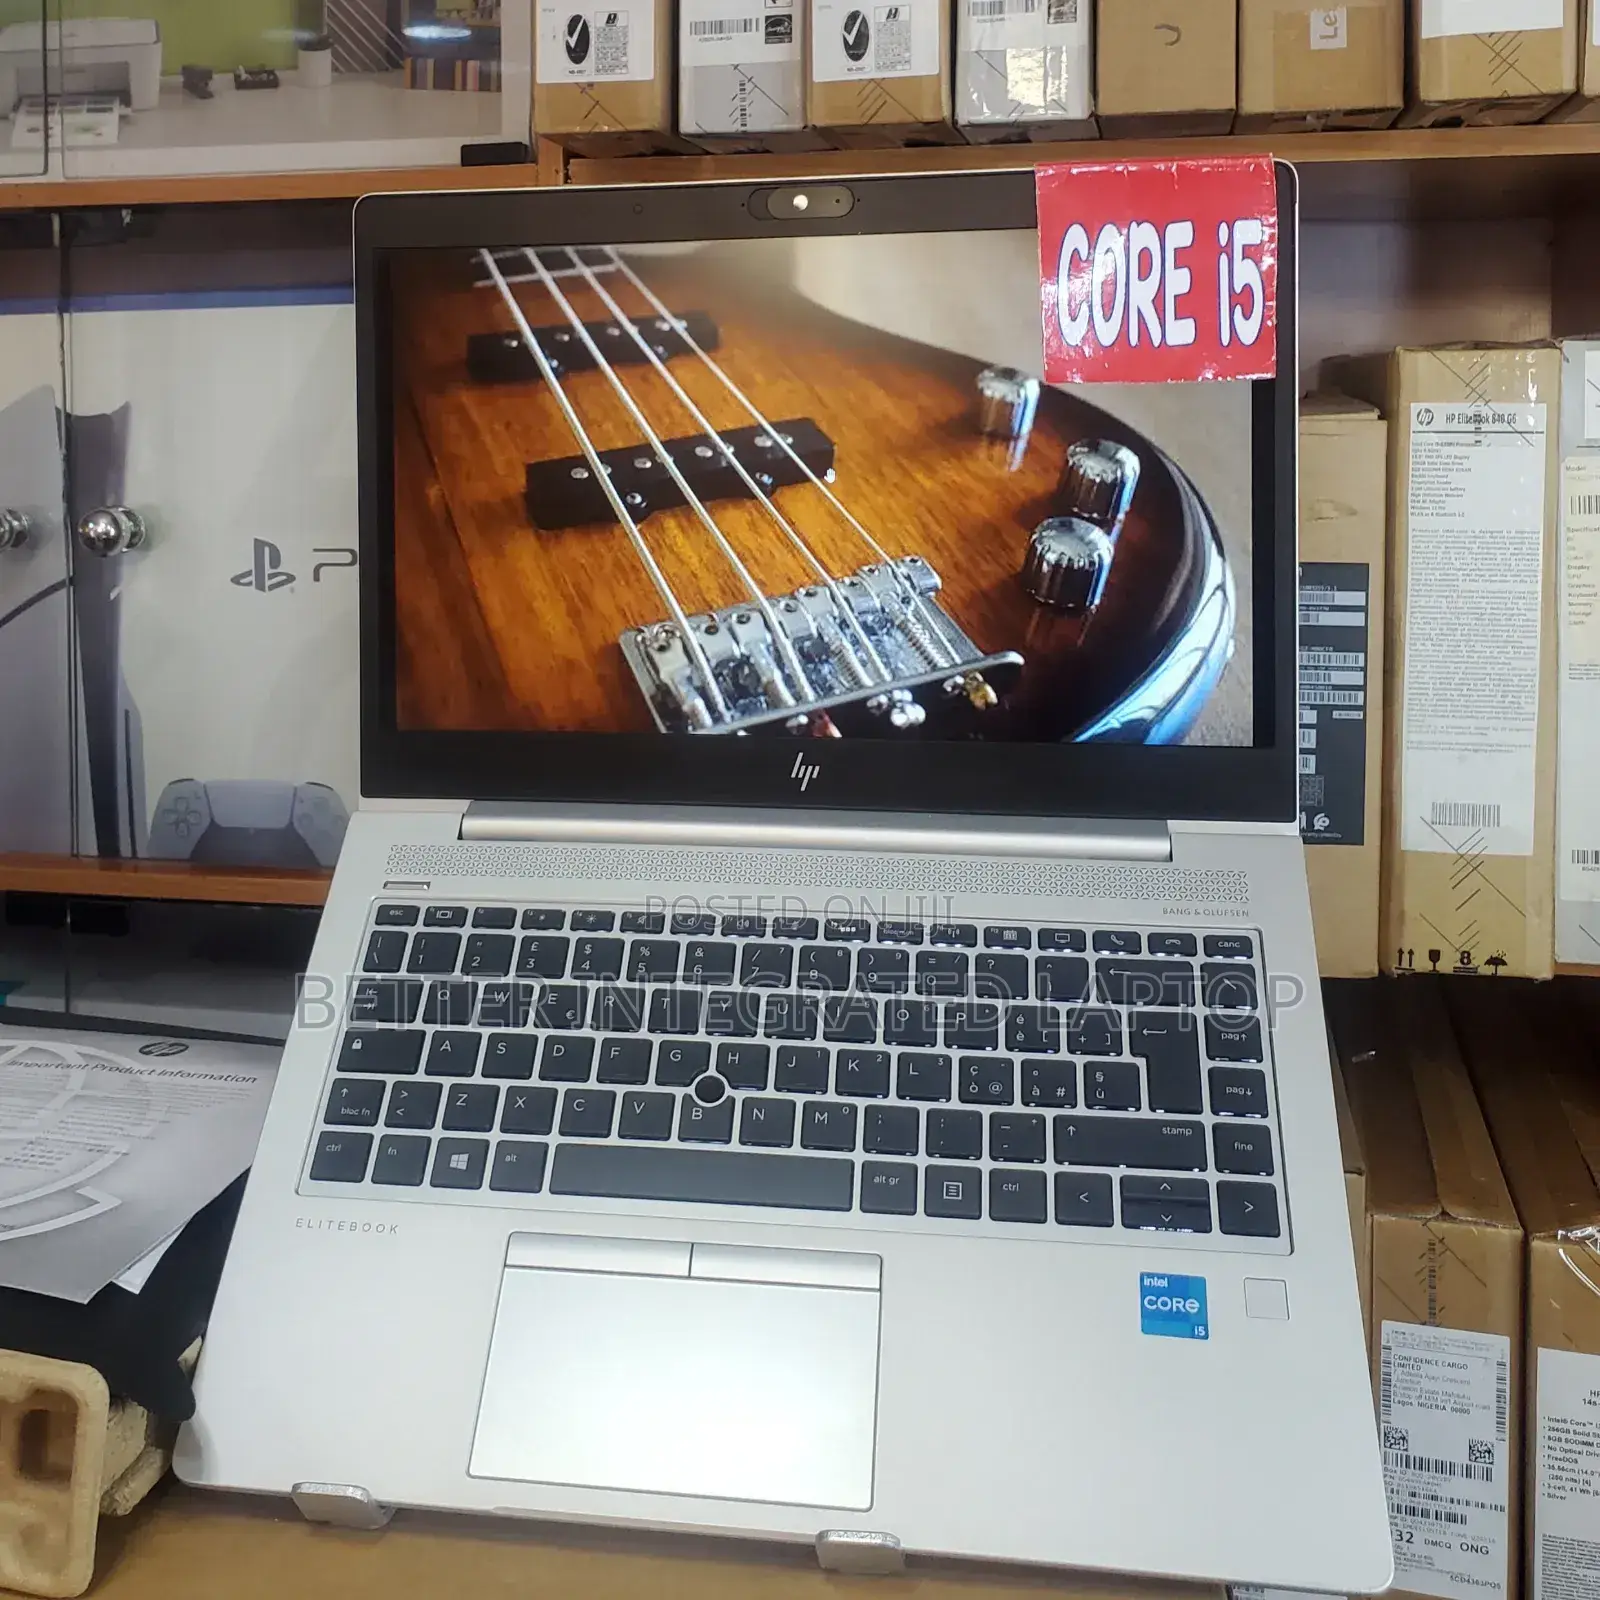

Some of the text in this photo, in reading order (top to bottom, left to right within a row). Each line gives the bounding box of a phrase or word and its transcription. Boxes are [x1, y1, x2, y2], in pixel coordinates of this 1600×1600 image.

[1057, 218, 1265, 348] CORE i5
[1445, 413, 1456, 424] HP
[1457, 413, 1490, 425] Eliteok
[389, 908, 404, 916] esc
[1162, 907, 1249, 917] BANG & OLUFSEN
[530, 942, 539, 951] £
[584, 944, 592, 954] $
[1218, 940, 1241, 949] canc
[640, 946, 650, 956] %
[694, 947, 704, 957] &
[418, 954, 424, 964] 1
[471, 956, 480, 967] 2
[526, 958, 535, 968] 3
[581, 960, 591, 970] 4
[987, 959, 995, 969] ?
[638, 962, 646, 973] 5
[693, 964, 702, 975] 6
[751, 966, 760, 978] 7
[809, 969, 818, 979] 8
[868, 972, 877, 982] 9
[438, 989, 450, 1001] Q
[494, 991, 510, 1003] W
[547, 993, 558, 1005] E
[604, 995, 615, 1007] R
[661, 997, 670, 1009] T
[720, 1000, 731, 1012] Y
[777, 1003, 789, 1015] U
[565, 1009, 575, 1020] €
[896, 1009, 909, 1021] O
[955, 1012, 967, 1024] P
[1016, 1013, 1025, 1025] é
[1016, 1030, 1025, 1041] è
[1042, 1030, 1048, 1043] [
[1078, 1034, 1087, 1044] +
[1105, 1033, 1111, 1045] ]
[1221, 1031, 1240, 1042] pag
[439, 1040, 452, 1052] A
[496, 1042, 507, 1055] S
[553, 1045, 565, 1057] D
[610, 1047, 621, 1059] F
[669, 1049, 682, 1062] G
[728, 1052, 740, 1065] H
[876, 1054, 883, 1063] 2
[787, 1056, 797, 1068] J
[848, 1059, 860, 1072] K
[937, 1057, 944, 1066] 3
[90, 1063, 156, 1076] Product
[157, 1068, 258, 1084] Information
[909, 1063, 919, 1076] L
[970, 1065, 978, 1076] ç
[1095, 1071, 1104, 1083] §
[969, 1081, 979, 1093] ò
[988, 1081, 1003, 1094] @
[1031, 1084, 1040, 1097] à
[1056, 1086, 1067, 1098] #
[1226, 1085, 1246, 1096] pag
[400, 1090, 409, 1099] >
[455, 1093, 468, 1106] Z
[1096, 1088, 1105, 1099] ù
[514, 1096, 527, 1109] X
[573, 1099, 585, 1112] C
[633, 1101, 646, 1115] V
[340, 1106, 371, 1117] bloc fn
[396, 1107, 405, 1116] <
[691, 1107, 703, 1120] B
[752, 1108, 765, 1121] N
[814, 1111, 828, 1124] M
[1161, 1126, 1193, 1138] stamp
[325, 1143, 341, 1152] ctrl
[387, 1147, 398, 1156] fn
[1233, 1141, 1253, 1152] fine
[504, 1153, 518, 1162] alt
[873, 1174, 900, 1186] alt gr
[1002, 1182, 1020, 1192] ctrl
[295, 1217, 399, 1235] ELITEBOOK
[1143, 1275, 1169, 1288] intel
[1393, 1353, 1469, 1371] CONFIDENCE CARGO
[1393, 1360, 1422, 1371] LIMITED
[1547, 1425, 1571, 1435] 256GB
[1572, 1429, 1591, 1438] Solid
[1547, 1444, 1557, 1452] No
[1559, 1446, 1584, 1455] Optical
[1547, 1453, 1579, 1464] FreeDOS
[1547, 1492, 1567, 1501] Silver
[1391, 1529, 1490, 1556] 32 DMCQ ONG
